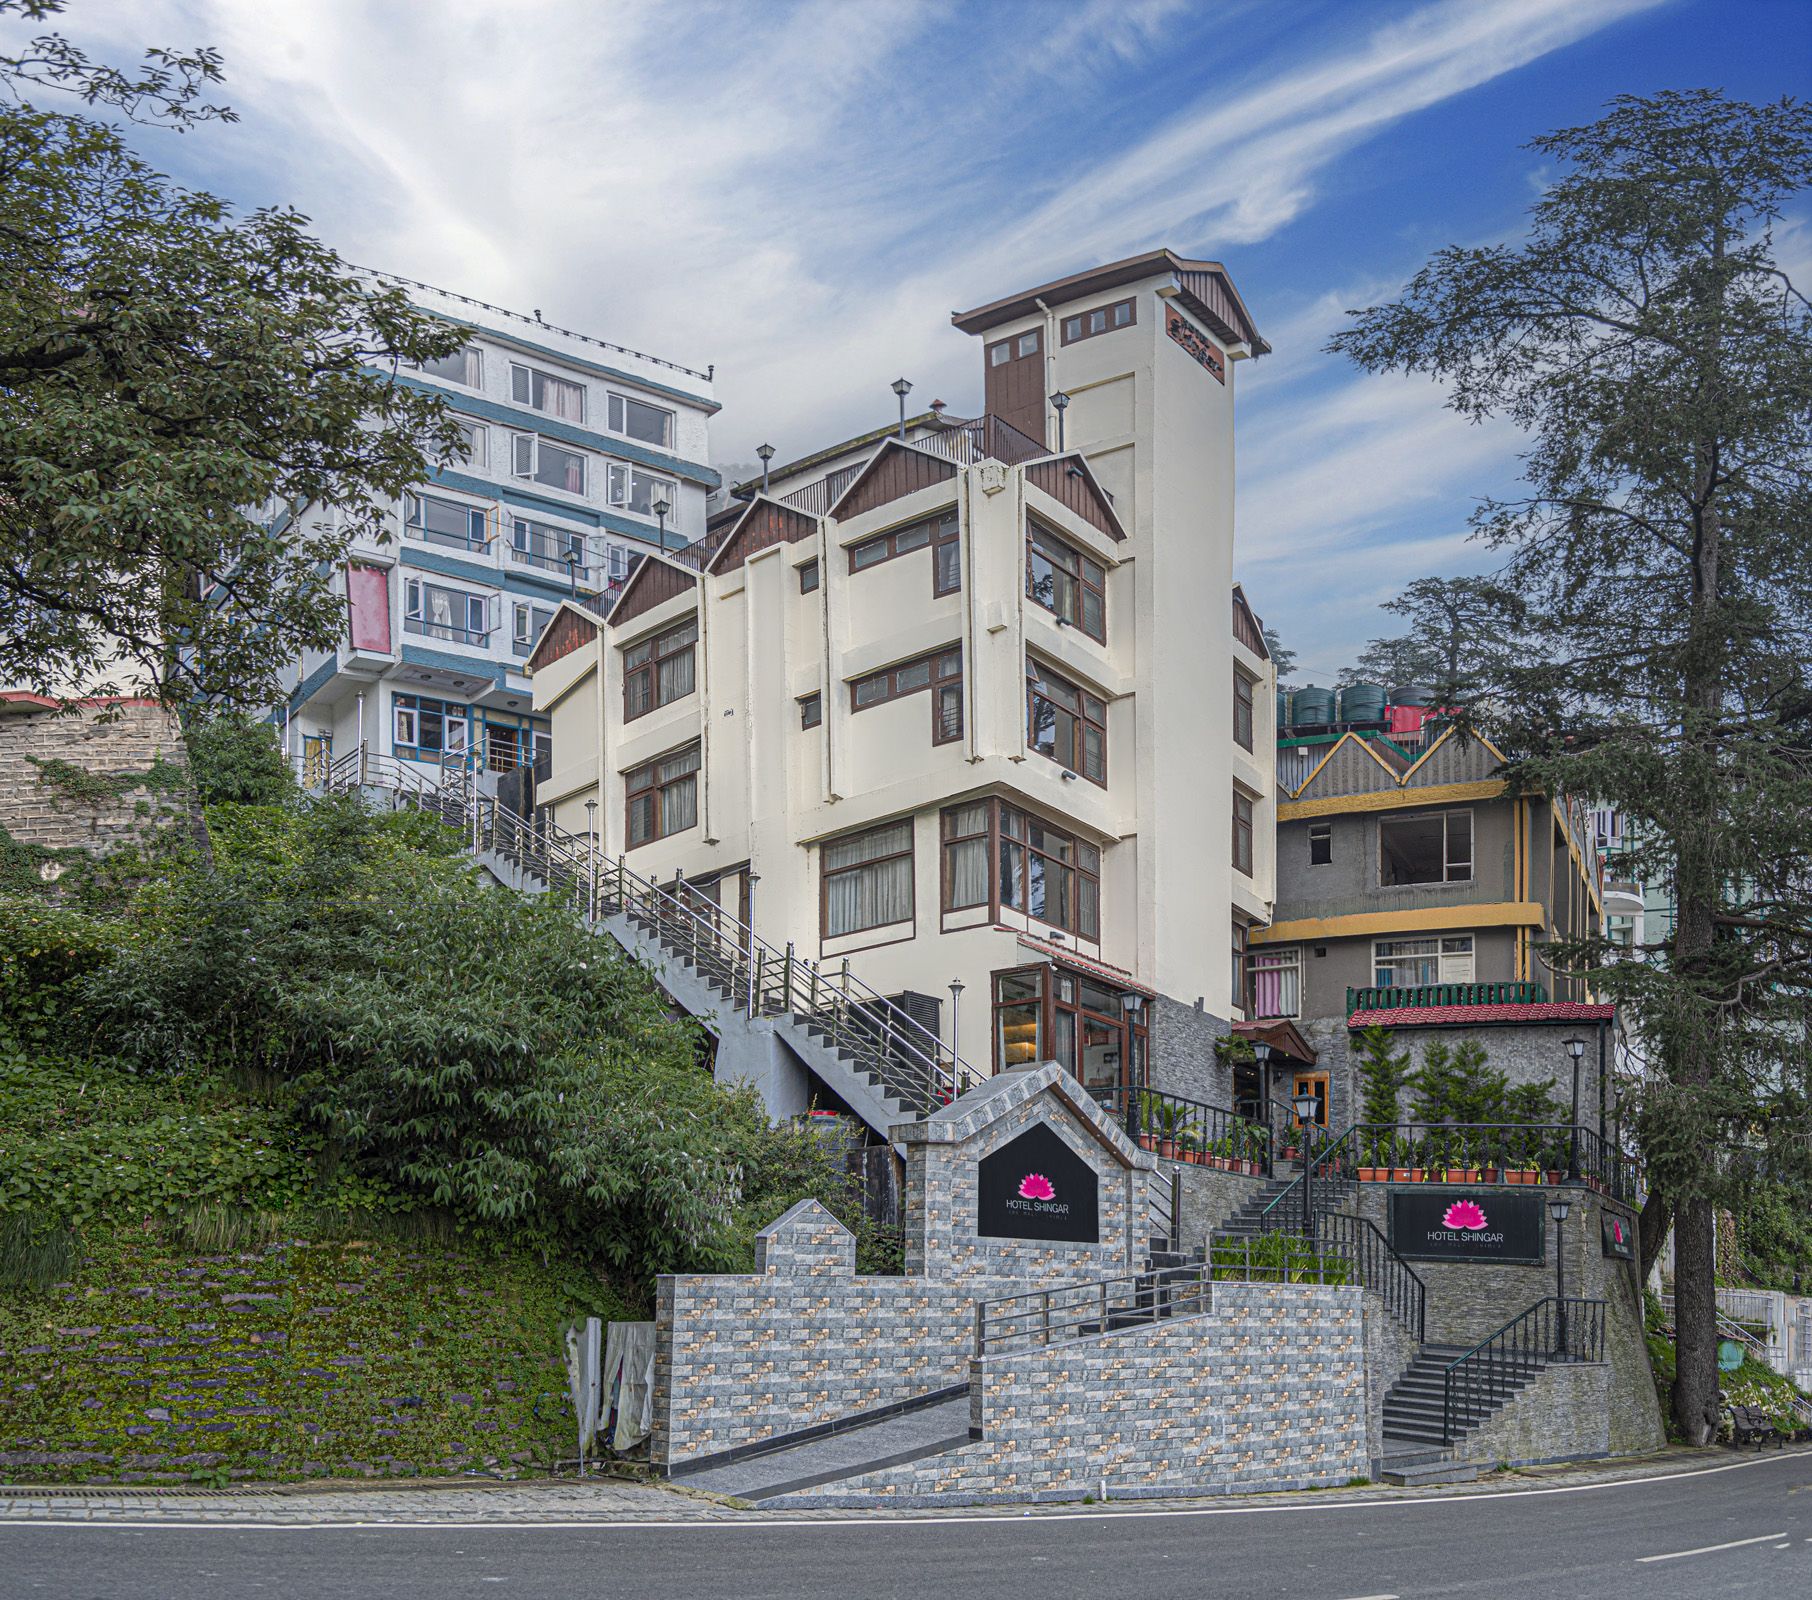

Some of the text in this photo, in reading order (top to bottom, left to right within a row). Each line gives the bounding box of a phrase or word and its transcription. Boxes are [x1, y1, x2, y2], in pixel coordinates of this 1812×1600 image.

[1006, 1199, 1069, 1214] HOTEL SHINGAR
[1427, 1231, 1504, 1242] HOTEL SHINGAR
